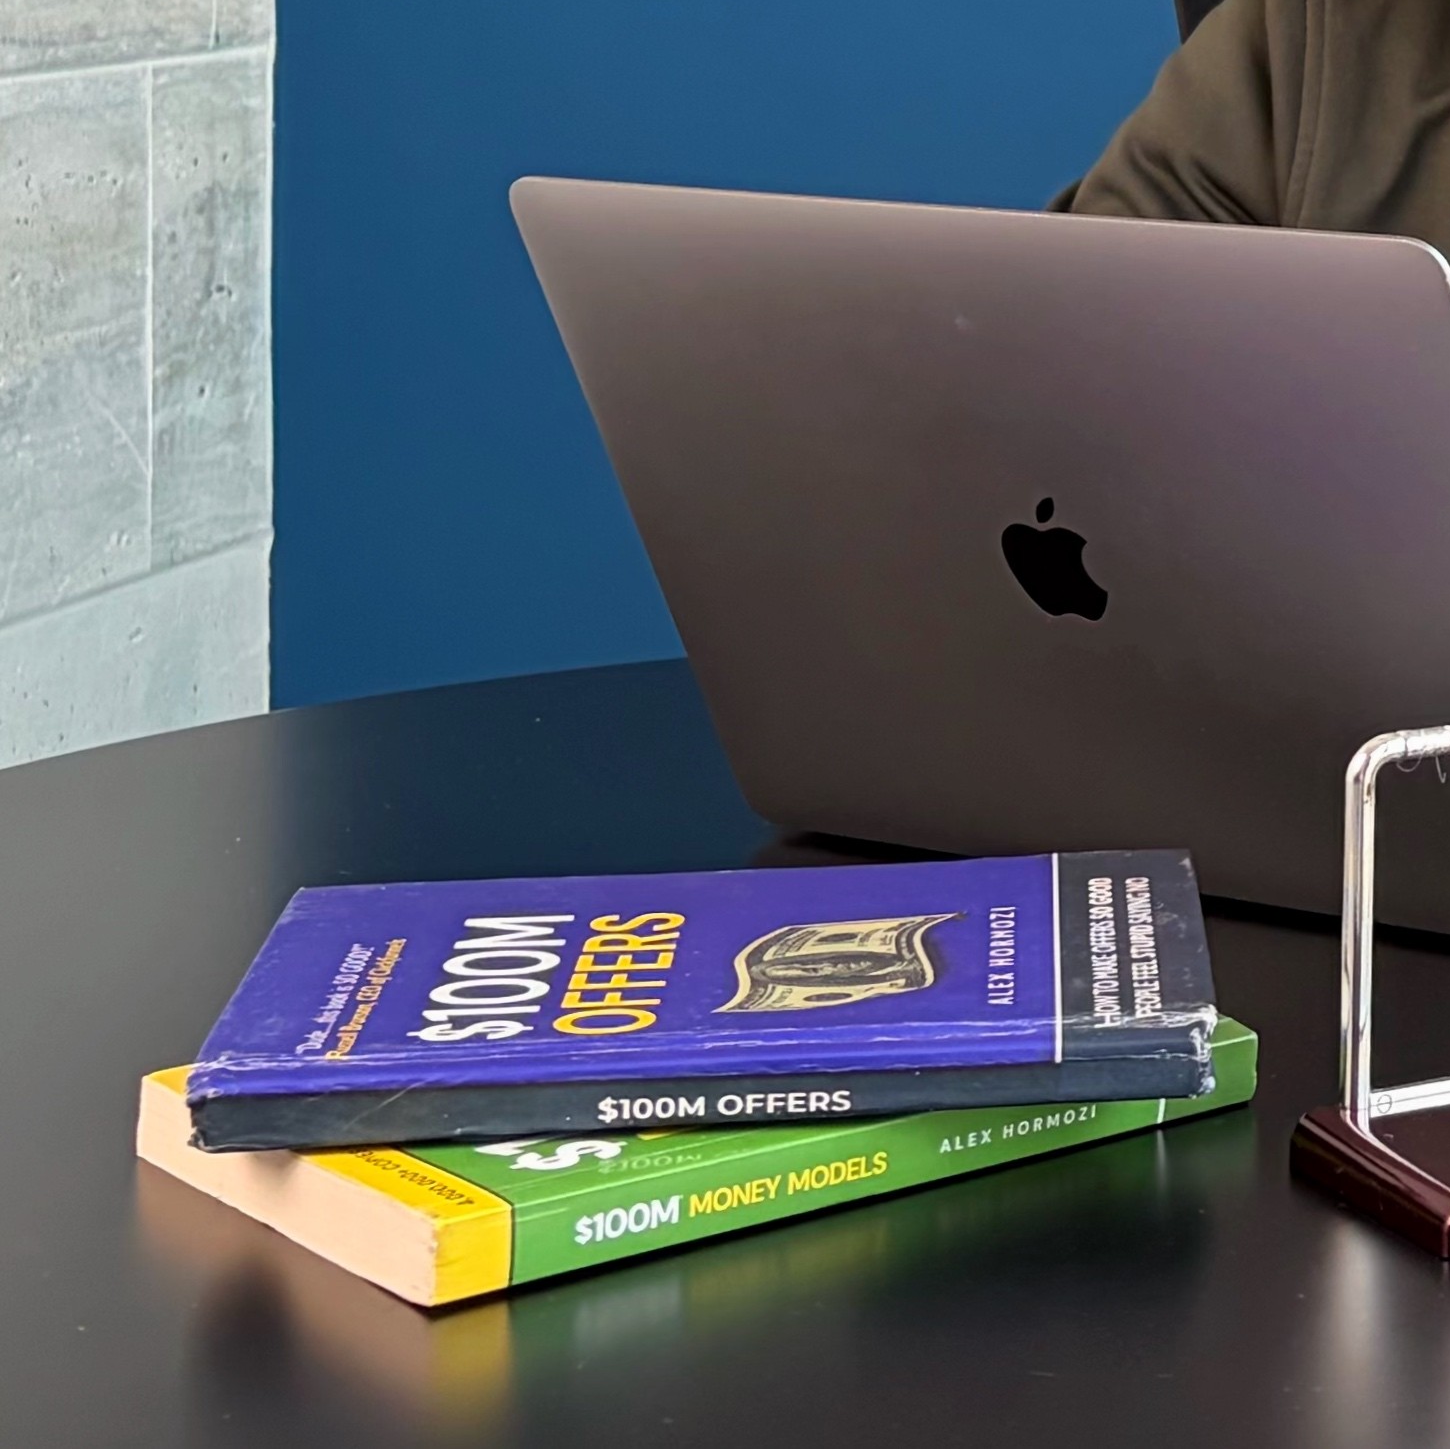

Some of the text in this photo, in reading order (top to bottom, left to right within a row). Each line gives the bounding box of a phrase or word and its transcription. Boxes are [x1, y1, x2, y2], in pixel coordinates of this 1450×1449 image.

[406, 914, 575, 1042] $100M
[552, 912, 686, 1035] OFFERS
[987, 971, 1014, 1005] ALEX
[1087, 877, 1122, 1028] HOW TO MAKE OFFERS SO GOOD
[1125, 876, 1162, 1018] PEOPLE FEEL STUPID SAYING NO
[597, 1090, 852, 1123] $100M OFFERS
[939, 1104, 1097, 1154] ALEX HORMOZI
[574, 1151, 888, 1245] $100M MONEY MODELS
